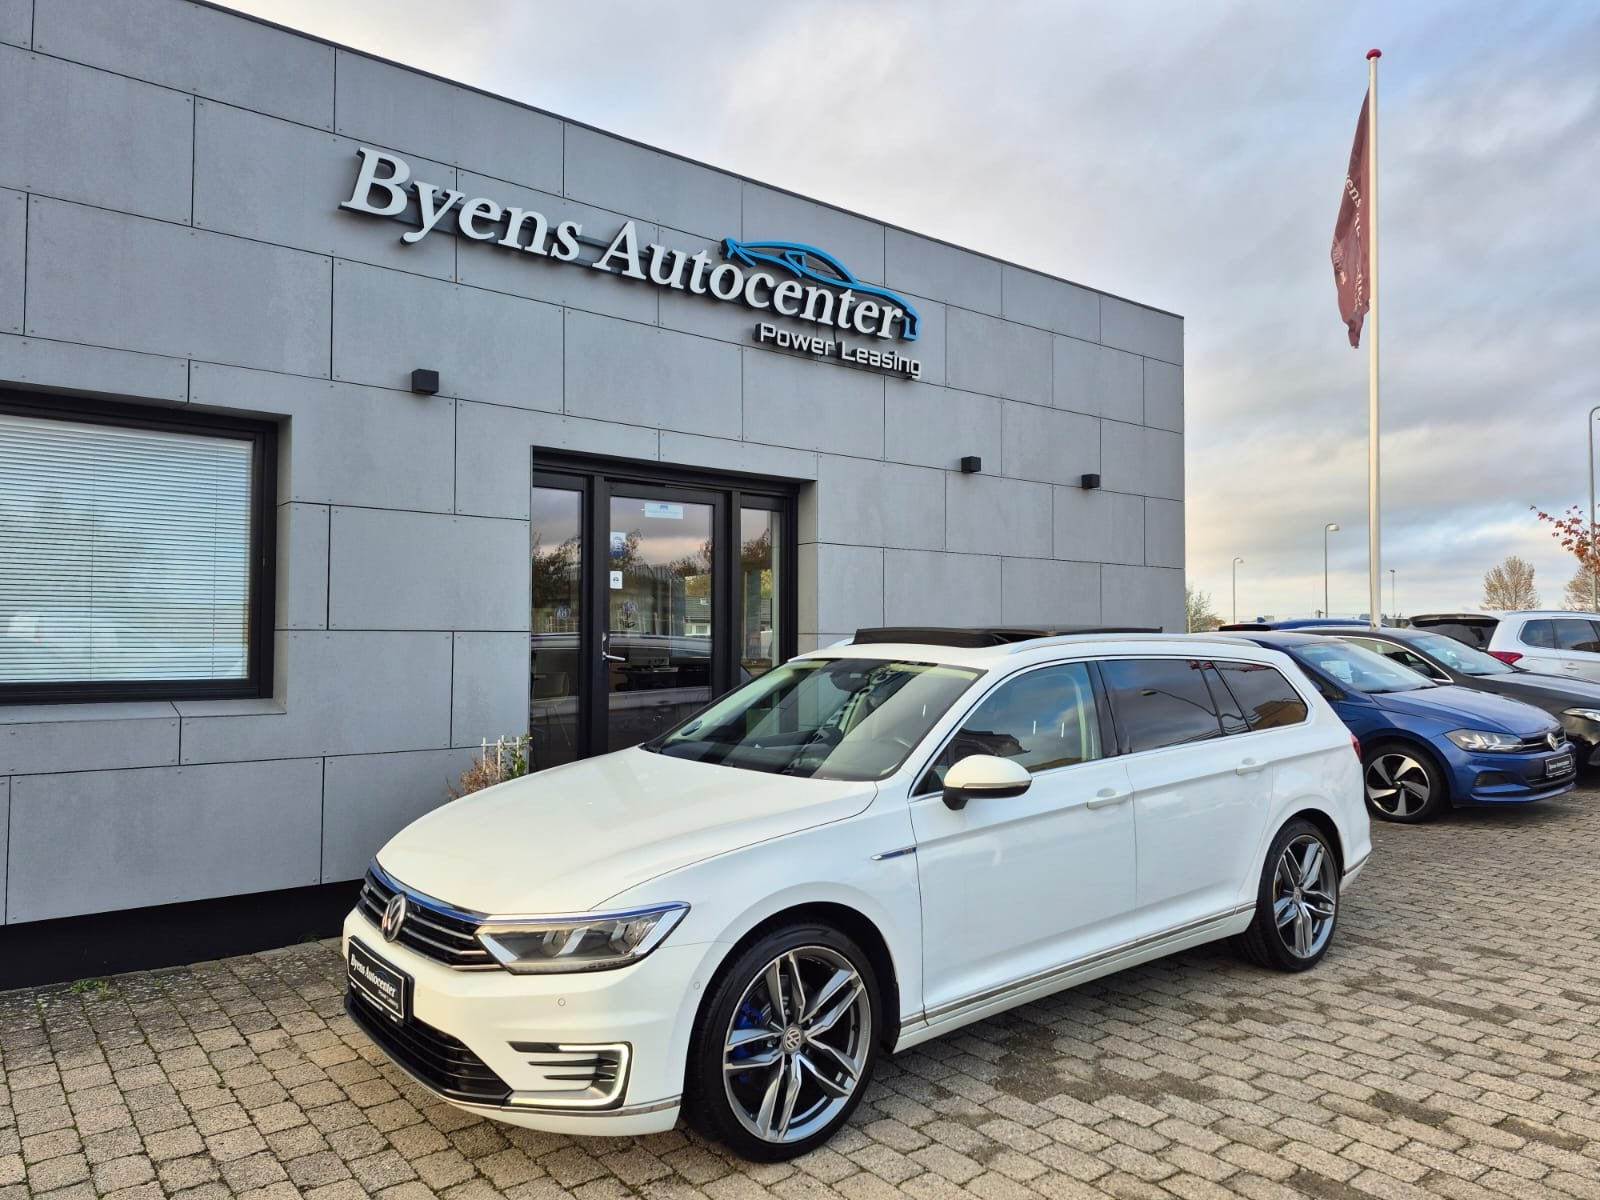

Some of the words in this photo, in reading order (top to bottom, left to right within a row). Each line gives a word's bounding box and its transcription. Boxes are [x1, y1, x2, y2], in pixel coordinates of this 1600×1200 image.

[339, 146, 583, 263] Byens
[592, 220, 902, 340] Autocenter
[759, 322, 835, 356] Power
[841, 341, 922, 379] Leasing
